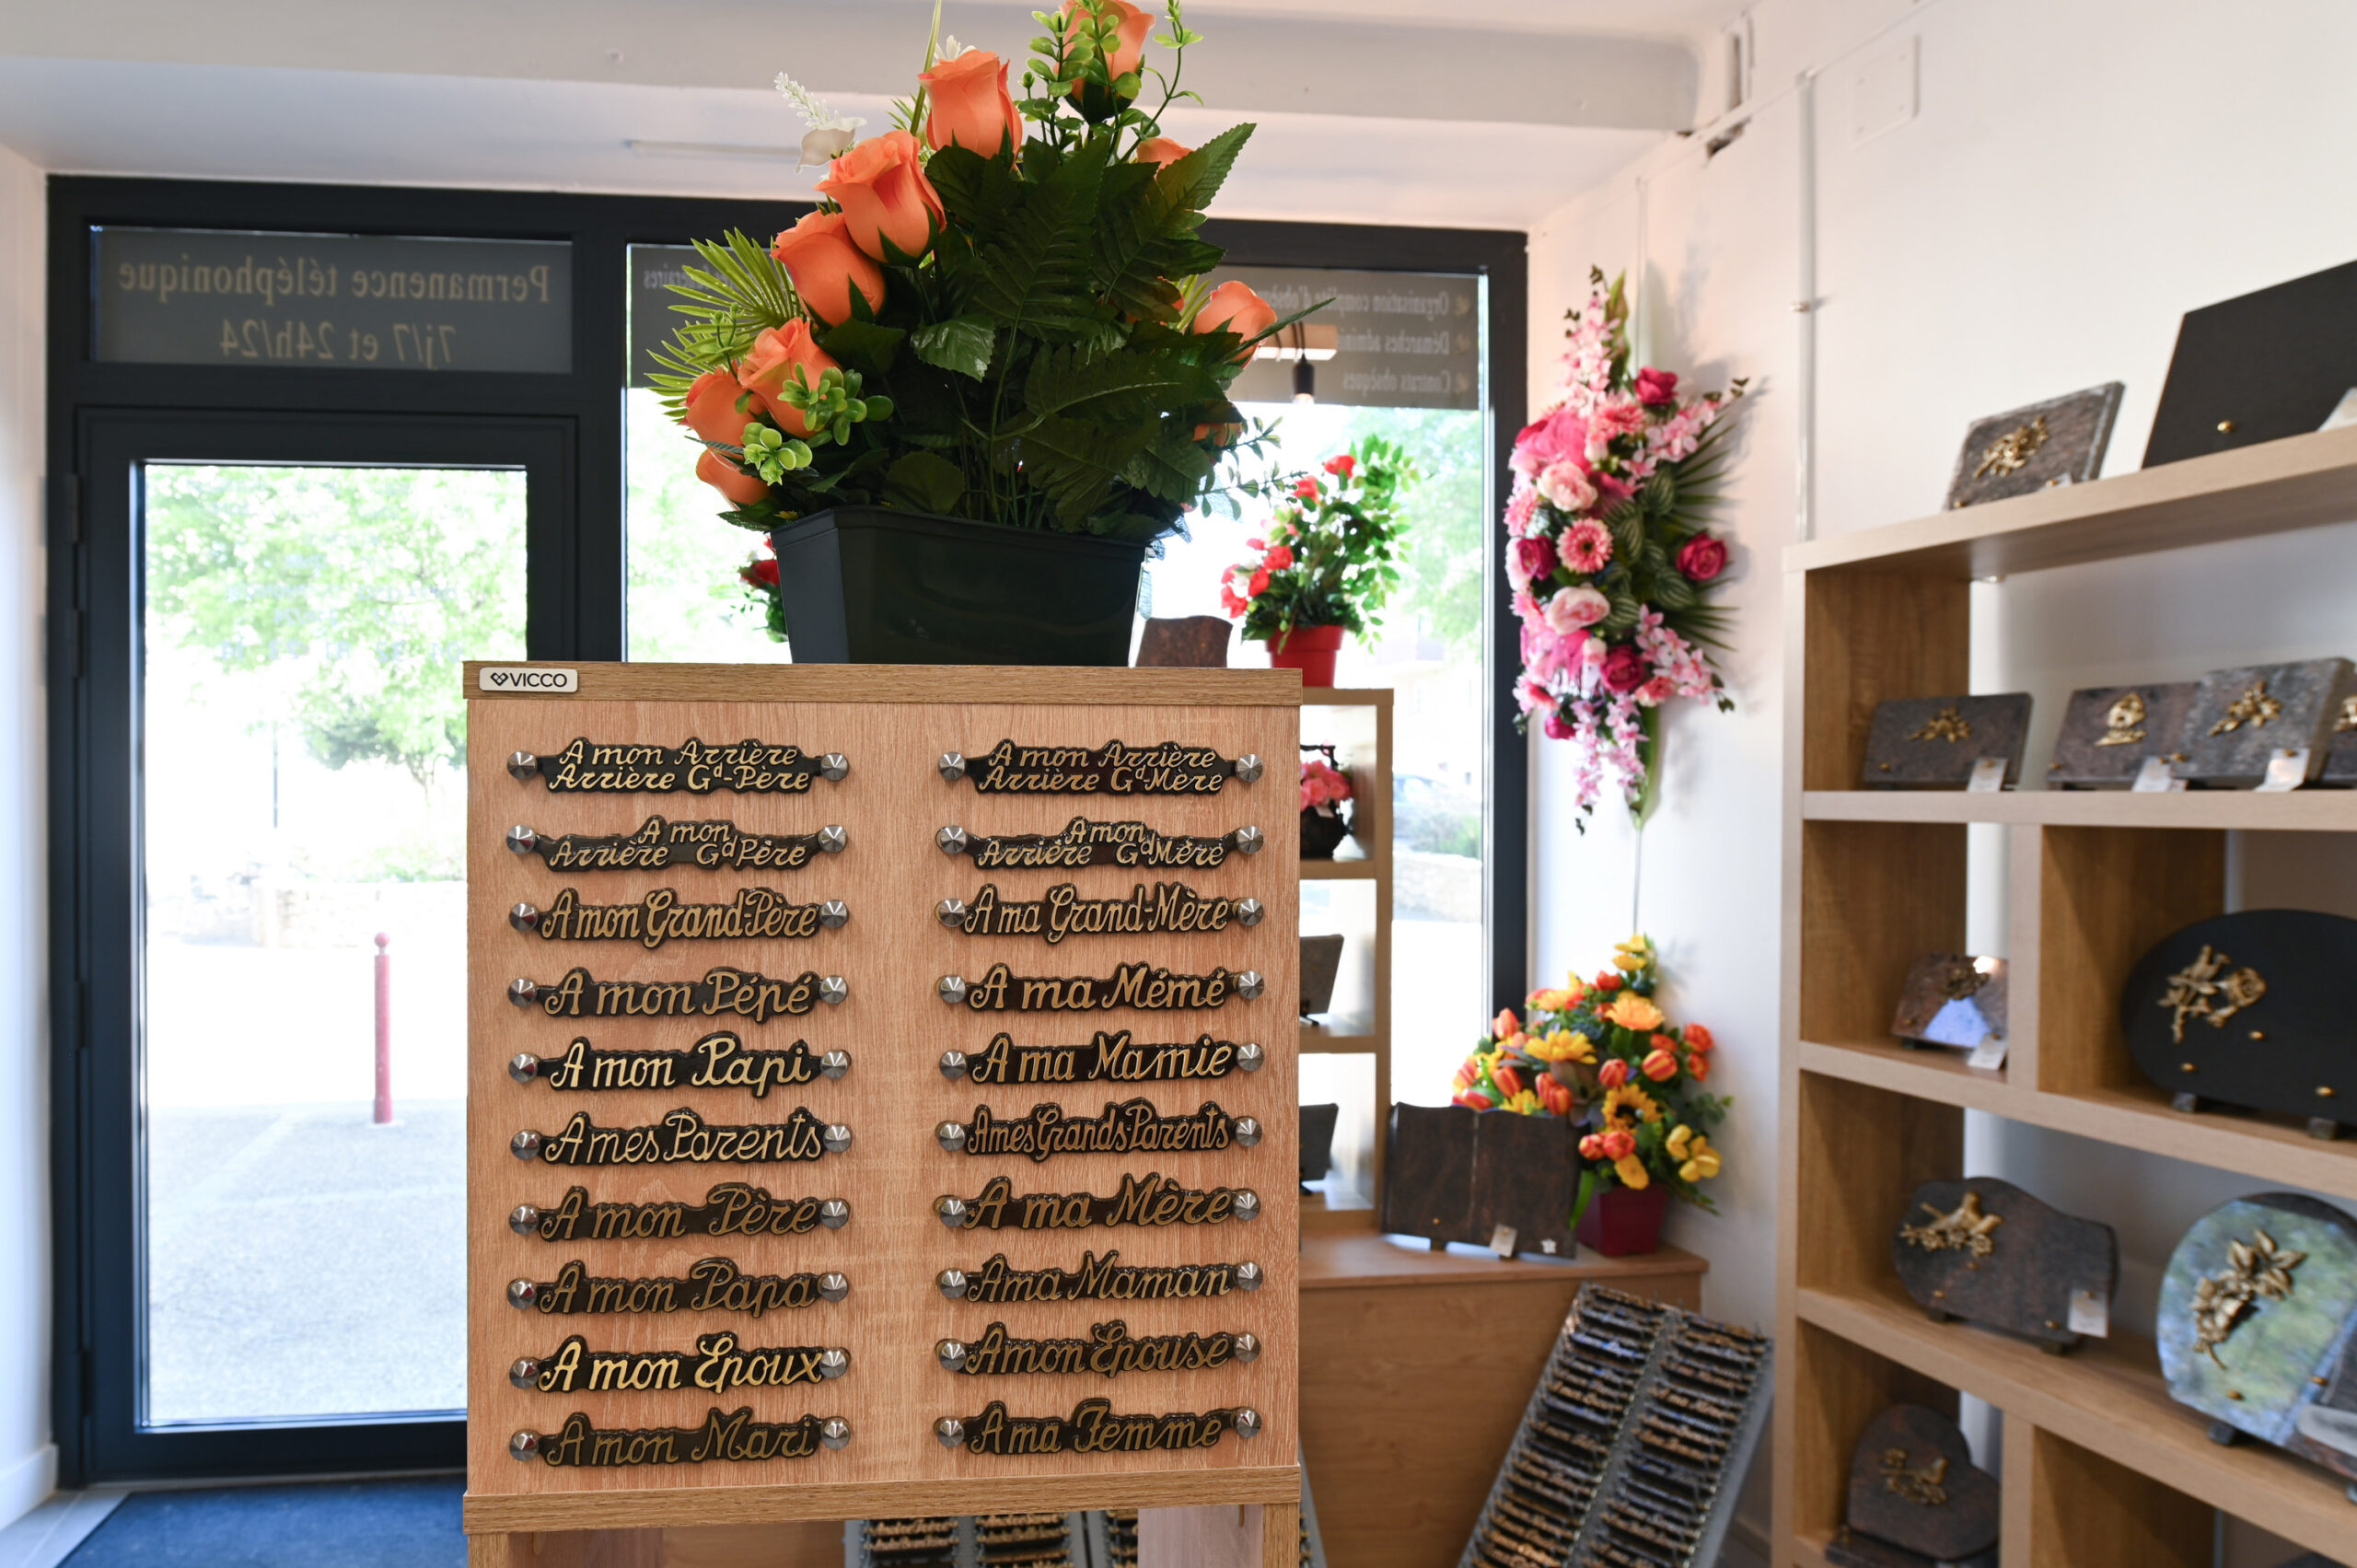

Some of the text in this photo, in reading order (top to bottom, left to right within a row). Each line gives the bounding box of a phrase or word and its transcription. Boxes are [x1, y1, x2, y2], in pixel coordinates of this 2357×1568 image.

[508, 672, 568, 689] VICCO
[550, 764, 677, 790] Arrière
[591, 747, 663, 766] mon
[673, 739, 797, 765] Arrière
[1019, 748, 1089, 768] mon
[1097, 743, 1216, 769] Arrière
[979, 765, 1099, 792] Arrière
[550, 841, 669, 867] Arrière
[669, 822, 730, 843] mon
[978, 838, 1093, 866] Arrière
[1044, 883, 1229, 944] Grand-Mère
[544, 970, 816, 1022] A mon Pépé
[970, 966, 1225, 1010] A ma Mémé
[550, 1036, 811, 1098] A mon Papi
[972, 1034, 1233, 1083] A ma Mamie
[663, 1113, 822, 1164] Parents
[591, 1206, 686, 1240] mon
[706, 1187, 818, 1237] Père
[1022, 1196, 1093, 1229] ma
[1106, 1176, 1232, 1227] Mère
[586, 1280, 679, 1314] mon
[691, 1261, 818, 1318] Papa
[1066, 1254, 1232, 1300] Maman
[587, 1357, 681, 1391] mon
[694, 1337, 823, 1394] Epoux
[1090, 1324, 1230, 1378] Epouse
[591, 1431, 679, 1466] mon
[691, 1413, 816, 1463] Mari
[1011, 1421, 1062, 1455] ma
[1074, 1404, 1224, 1454] Femme
